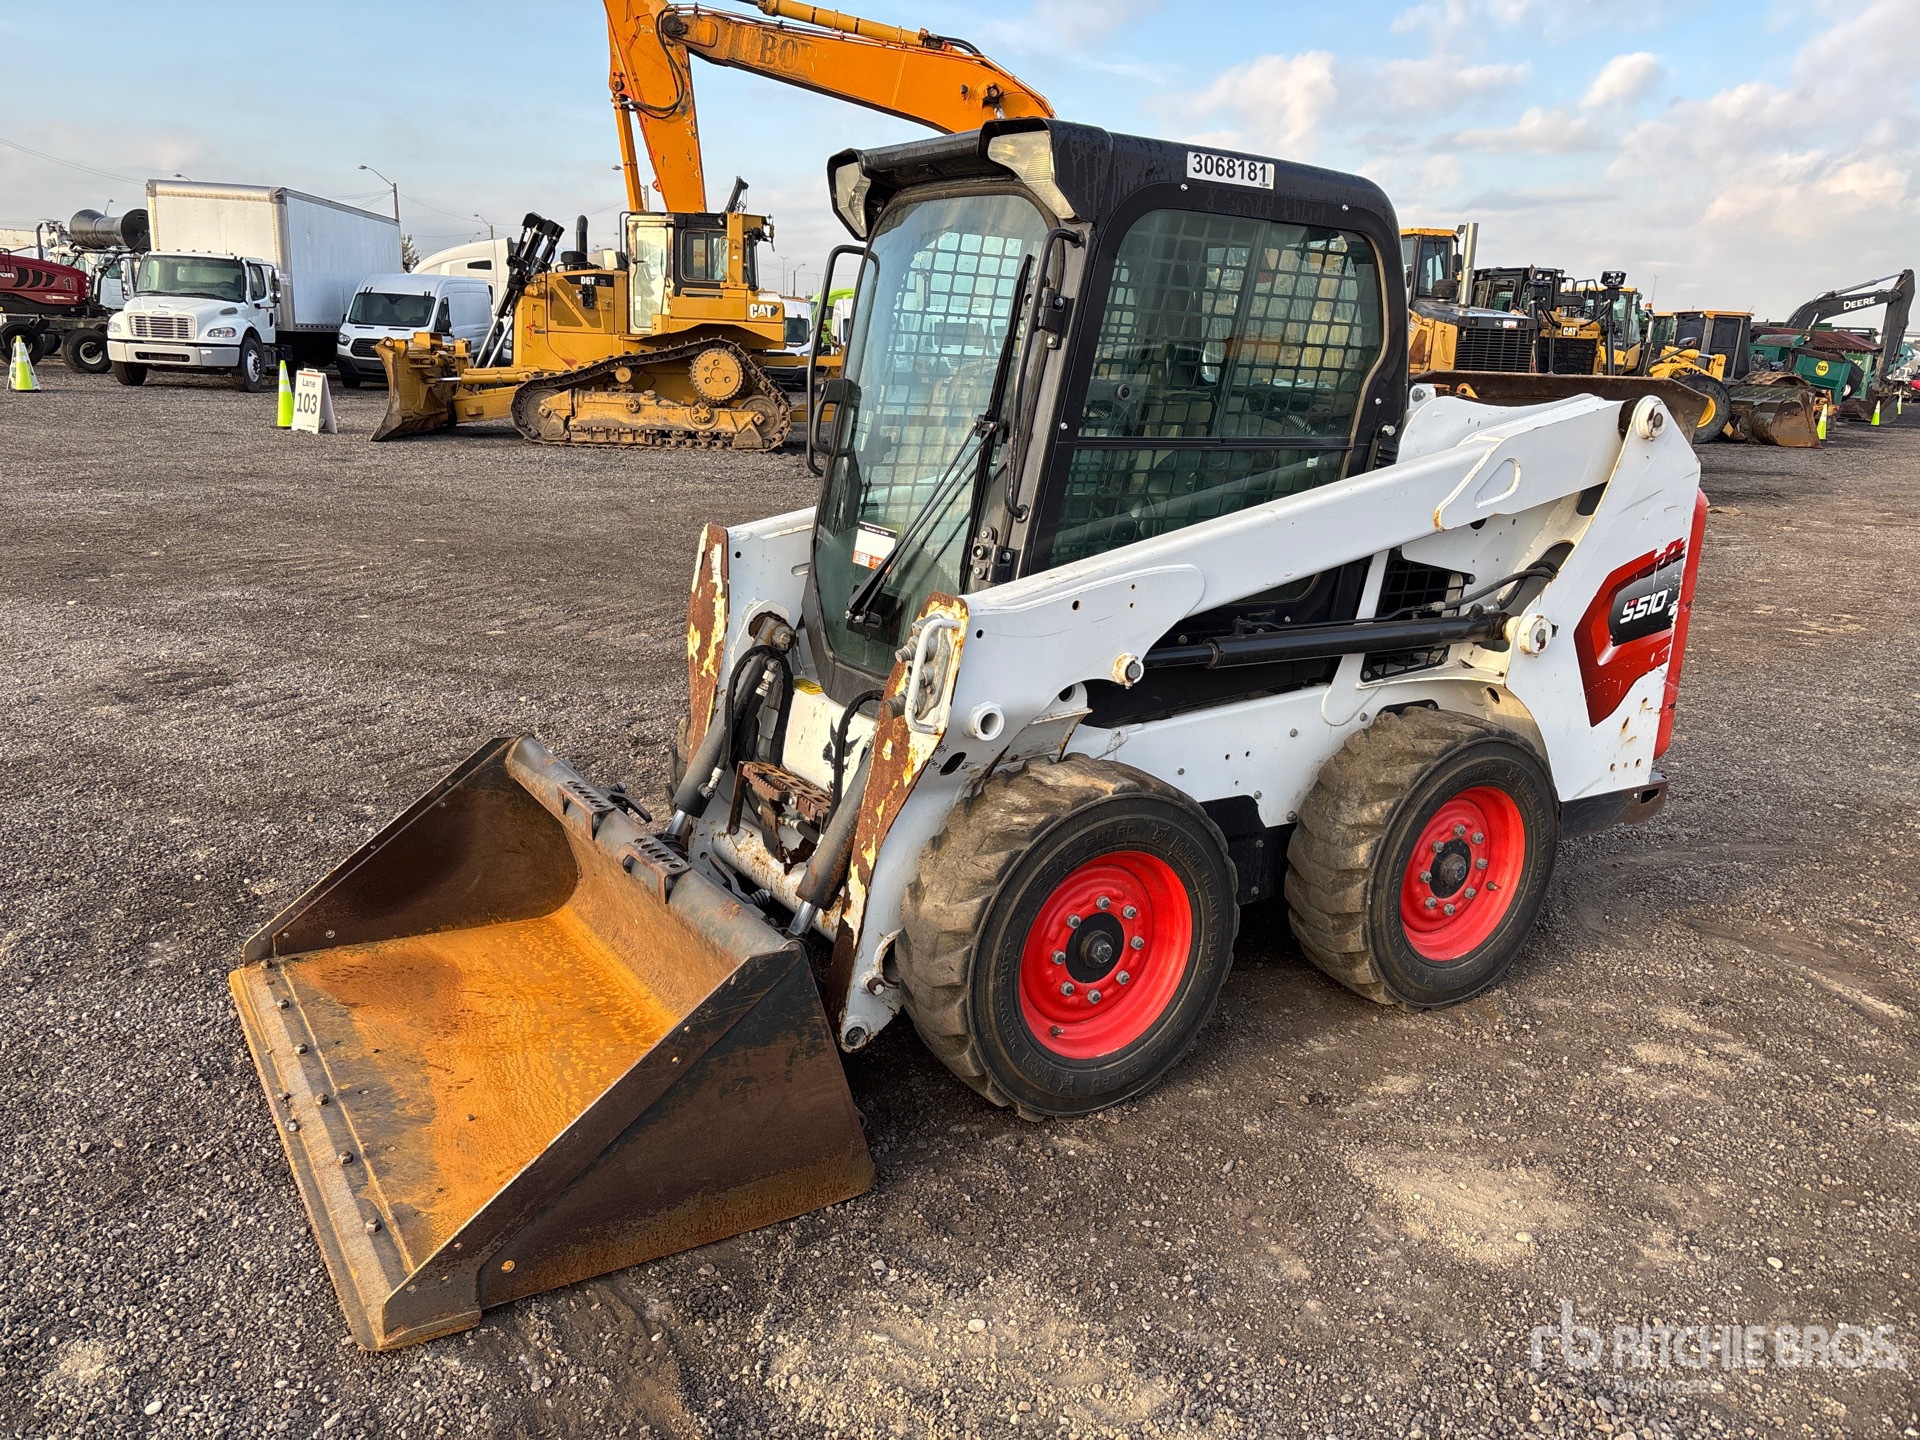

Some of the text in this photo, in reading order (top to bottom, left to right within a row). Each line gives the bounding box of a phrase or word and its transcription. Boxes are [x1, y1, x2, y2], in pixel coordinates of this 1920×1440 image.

[1192, 153, 1267, 183] 3068181
[580, 276, 595, 285] D6T
[1843, 296, 1876, 310] DEERE
[749, 303, 773, 319] CAT
[1563, 326, 1577, 336] CAT
[302, 378, 316, 388] Lane
[296, 392, 318, 414] 103
[1619, 589, 1669, 624] S510
